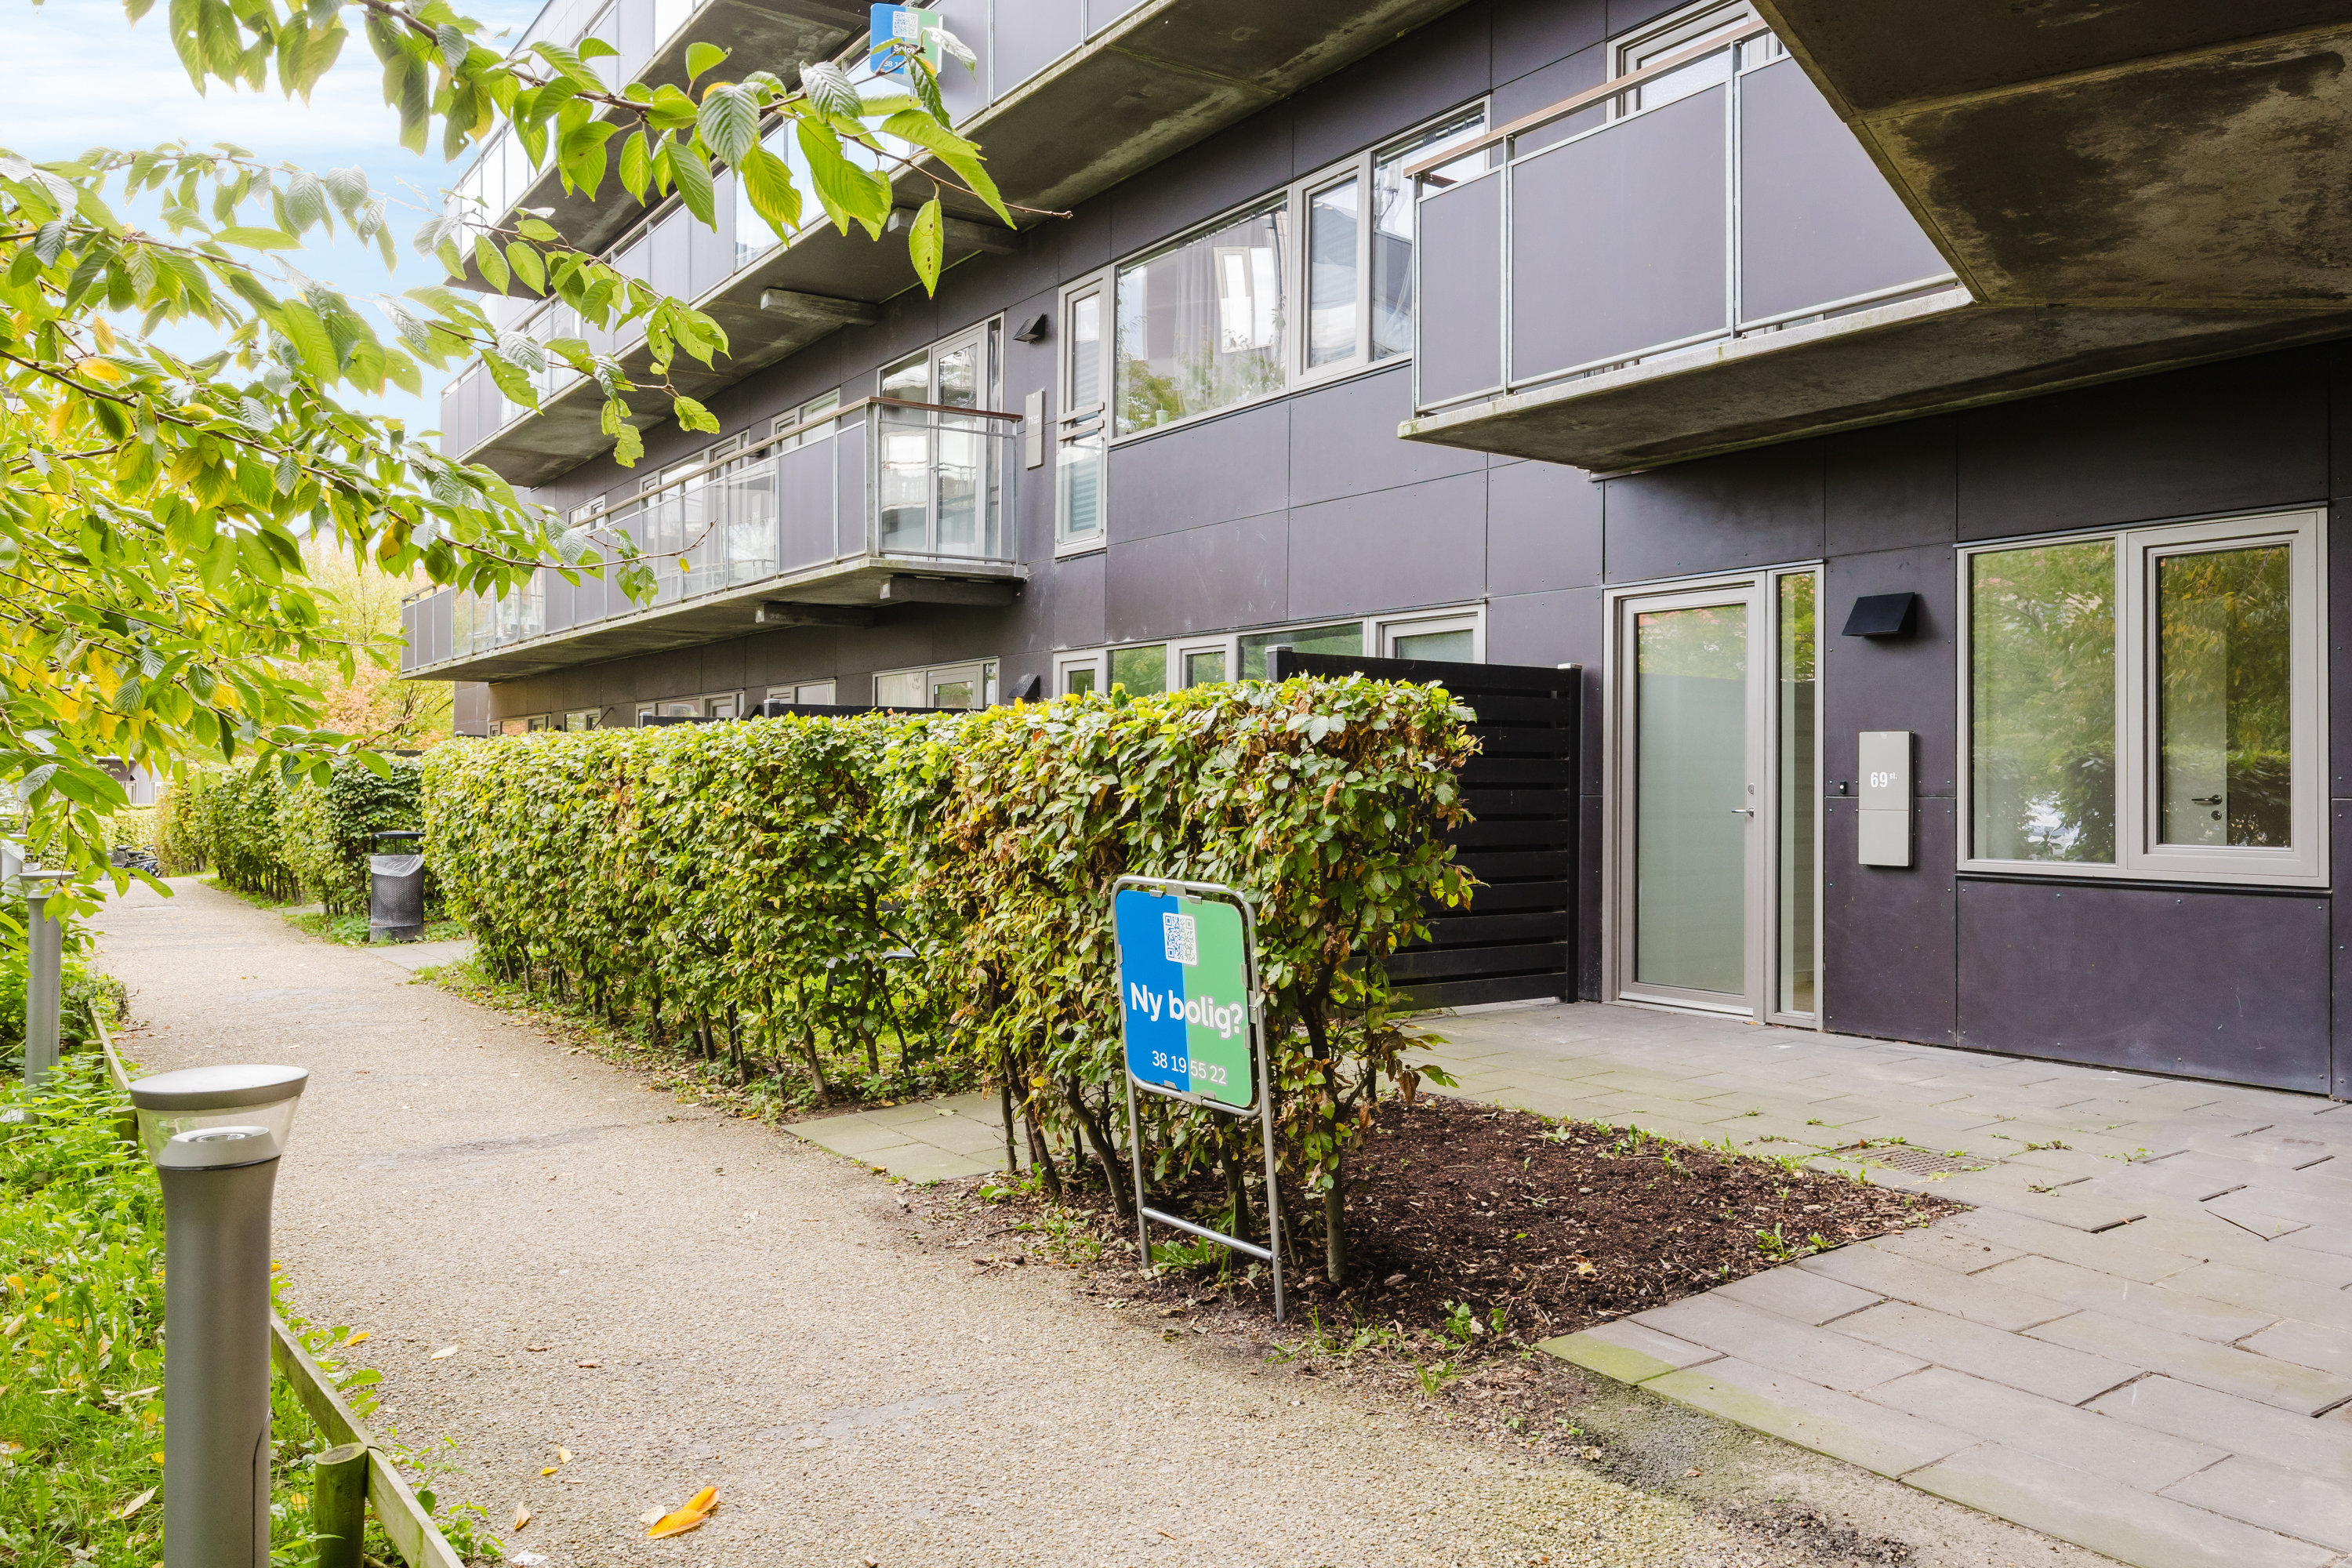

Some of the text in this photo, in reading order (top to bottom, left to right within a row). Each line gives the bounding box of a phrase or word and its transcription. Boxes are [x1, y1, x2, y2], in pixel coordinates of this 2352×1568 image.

[1871, 771, 1888, 787] 69
[1131, 982, 1243, 1039] Ny bolig?
[1152, 1051, 1228, 1085] 38 19 55 22
